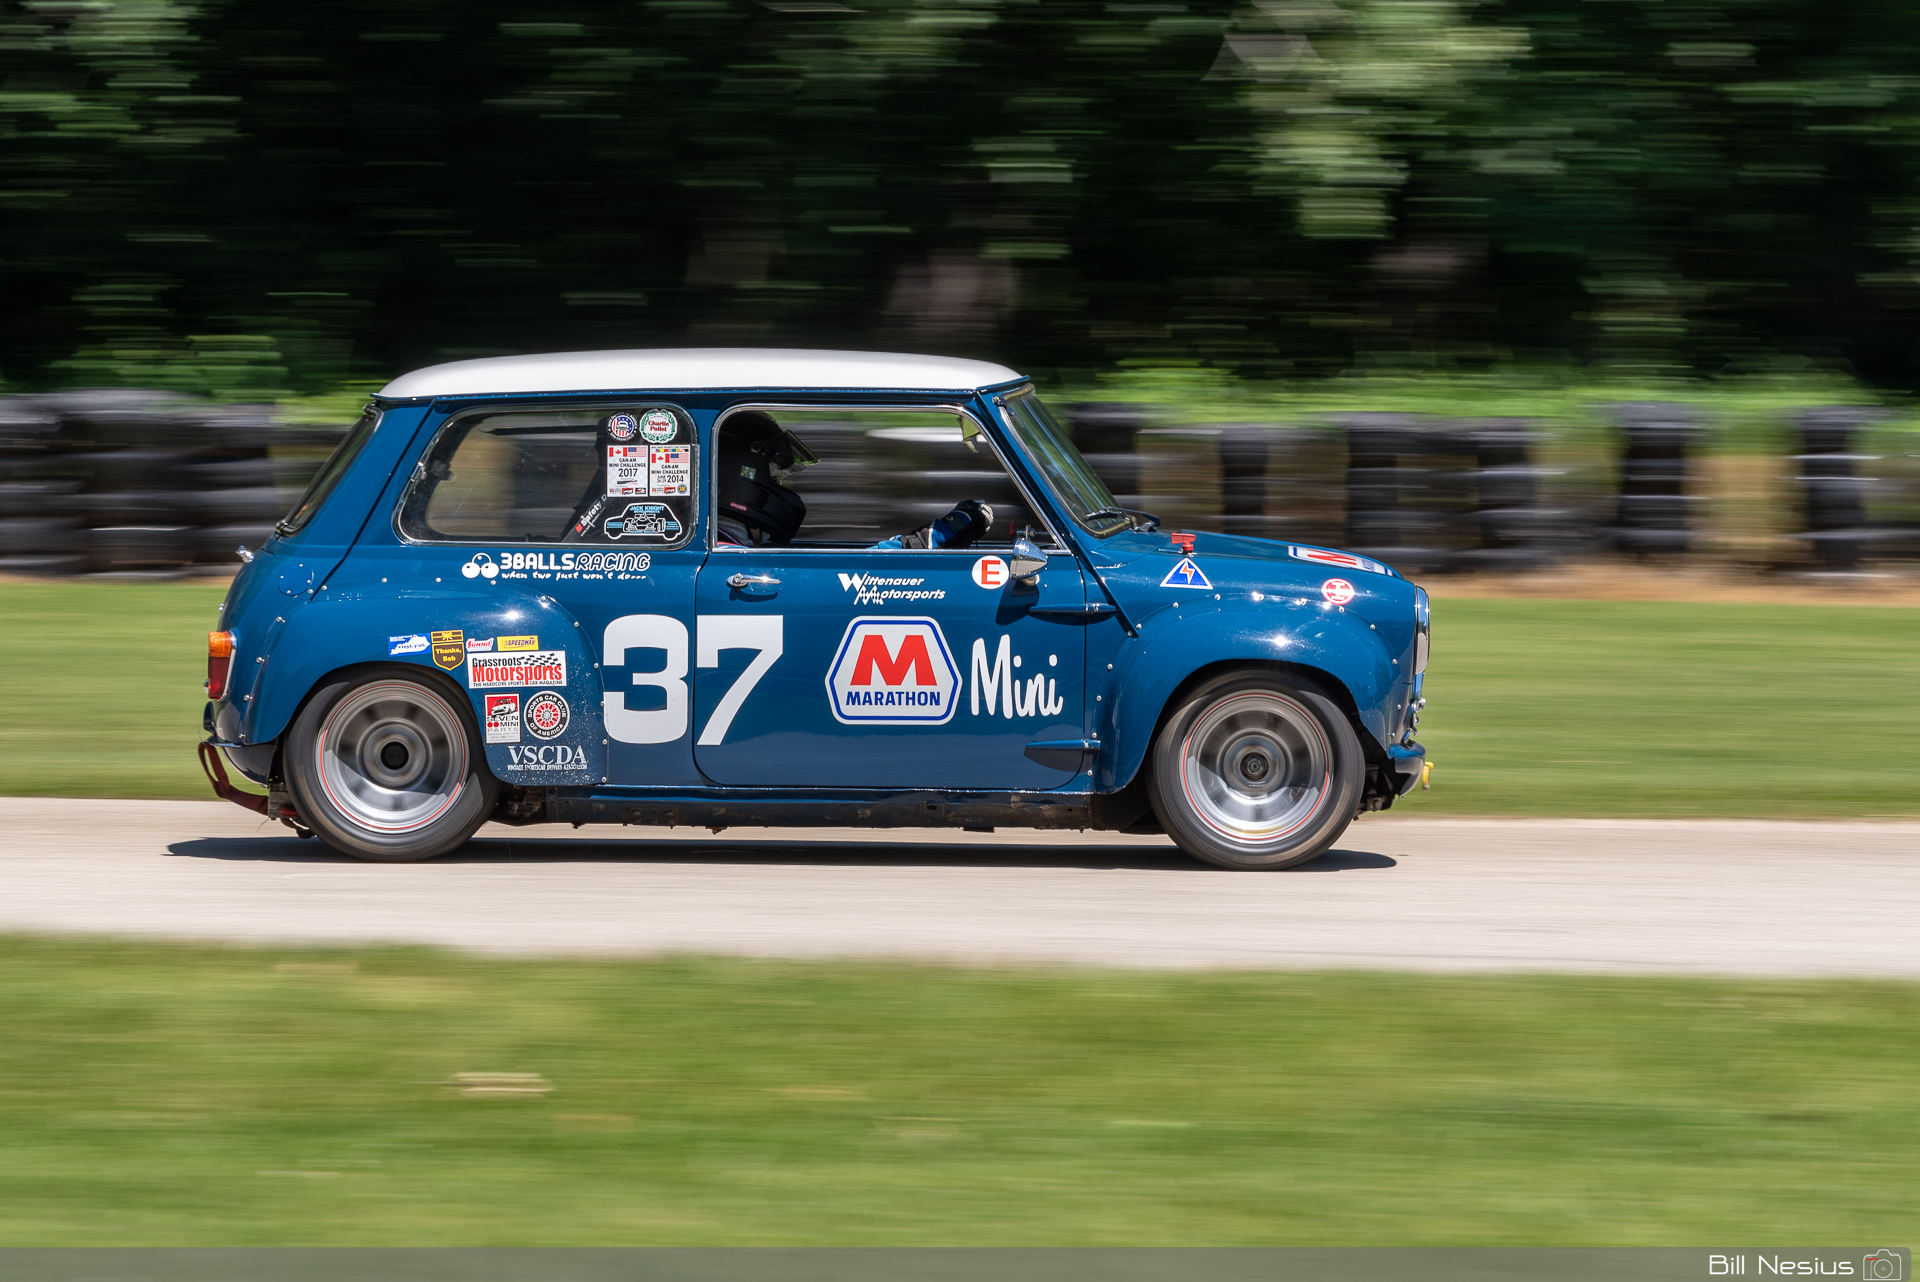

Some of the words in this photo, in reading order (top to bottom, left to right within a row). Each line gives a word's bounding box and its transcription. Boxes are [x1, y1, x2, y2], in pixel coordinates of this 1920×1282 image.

[618, 468, 638, 477] 2017
[581, 501, 602, 526] Safety
[502, 571, 528, 580] when
[532, 571, 552, 579] two
[556, 571, 579, 580] just
[582, 571, 613, 580] won't
[838, 571, 925, 592] Wittenauer
[981, 559, 1000, 585] E
[853, 585, 946, 606] Motorsports
[472, 657, 522, 667] Grassroots
[850, 634, 938, 686] M
[472, 664, 562, 685] Motorsports
[603, 614, 784, 746] 37
[970, 634, 1064, 720] Mini
[528, 695, 544, 718] SPORTS
[544, 694, 558, 702] CAR
[557, 700, 566, 718] CLUB
[846, 691, 940, 706] MARATHON
[530, 722, 538, 731] OF
[537, 724, 564, 736] AMERICA
[508, 744, 588, 764] VSCDA
